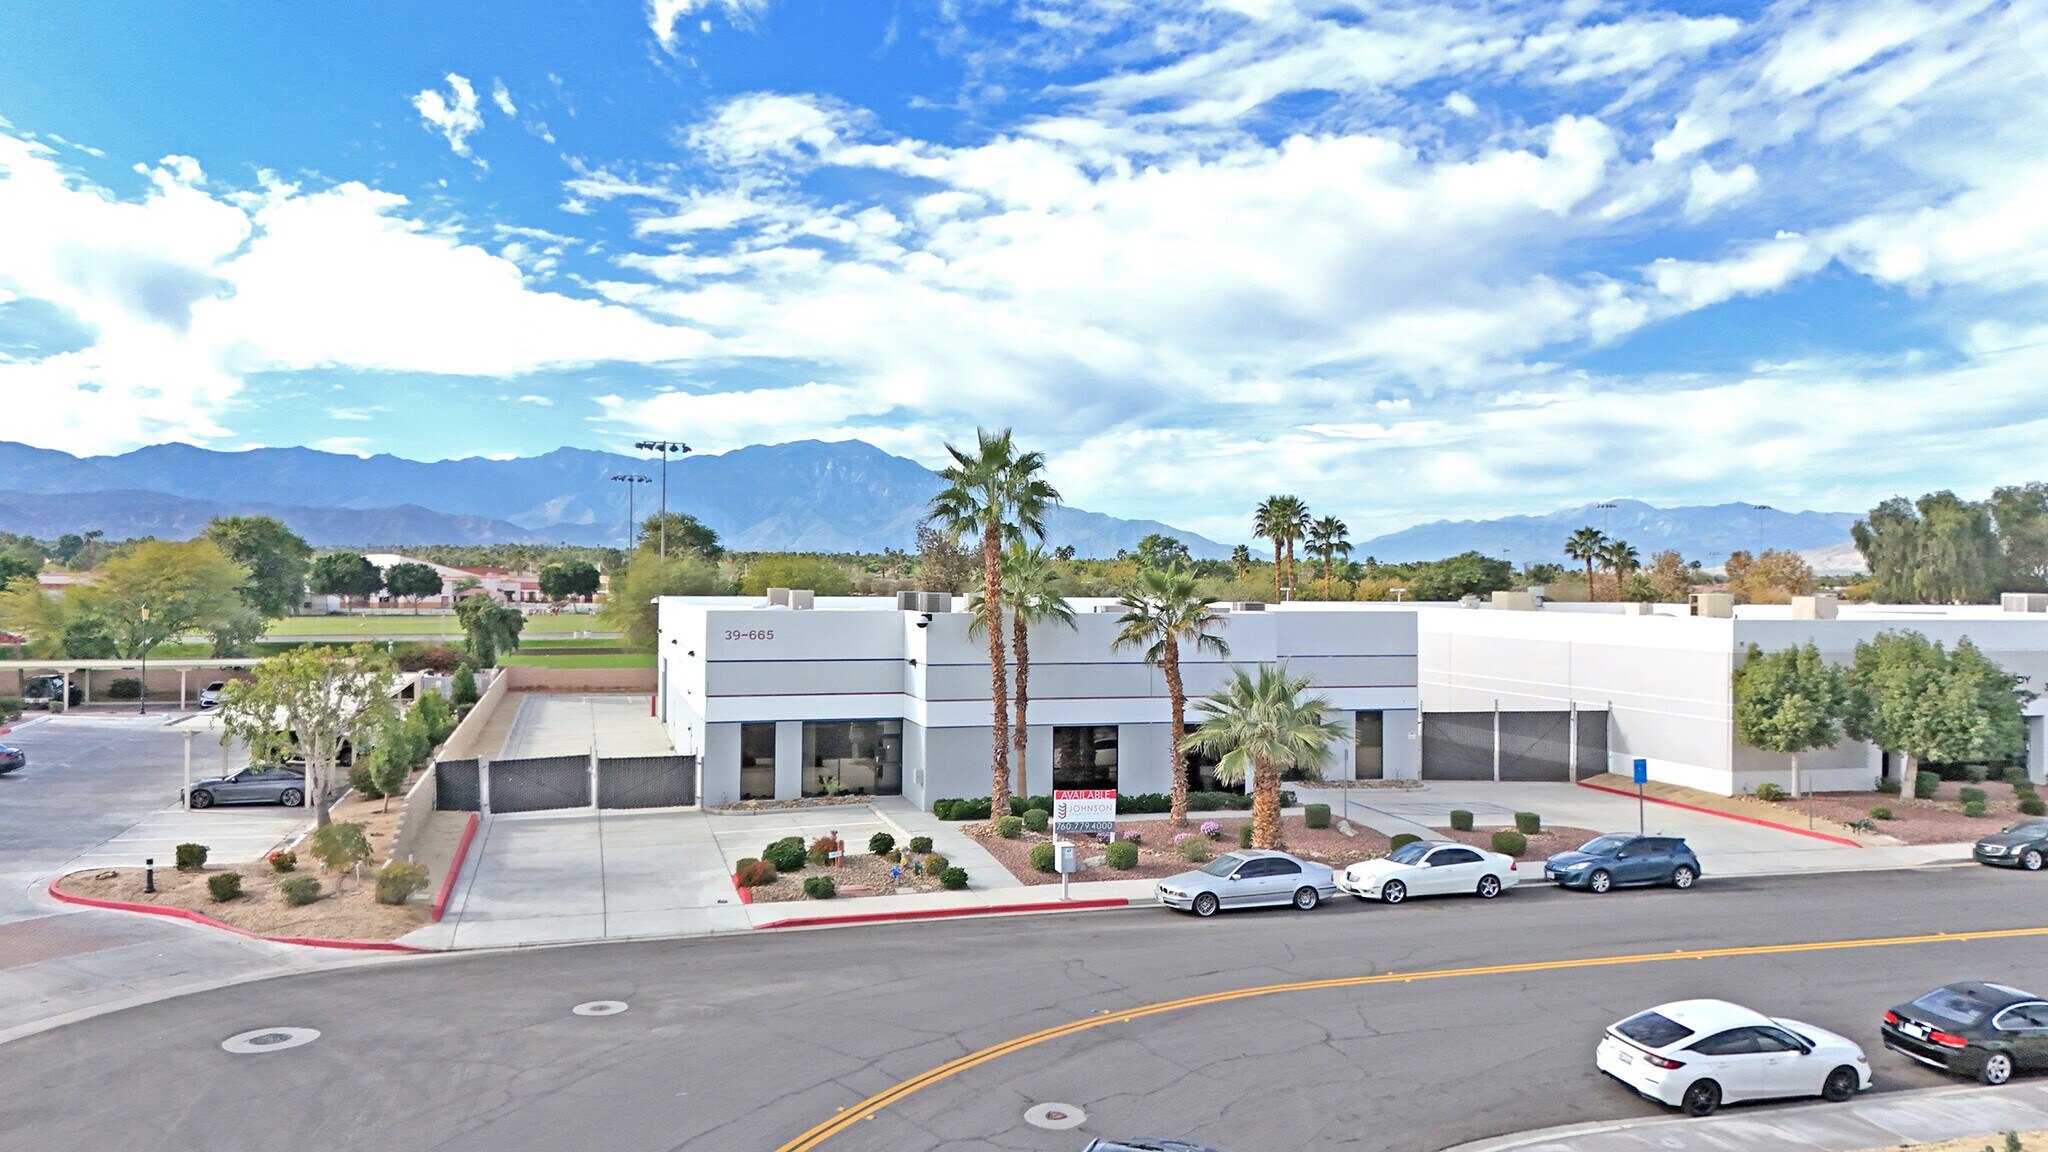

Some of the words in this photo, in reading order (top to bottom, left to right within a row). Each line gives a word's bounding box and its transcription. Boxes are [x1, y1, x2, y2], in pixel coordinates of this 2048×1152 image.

[724, 630, 774, 640] 39-665
[1060, 790, 1110, 800] AVAILABLE
[1056, 822, 1112, 830] 760.779.4000
